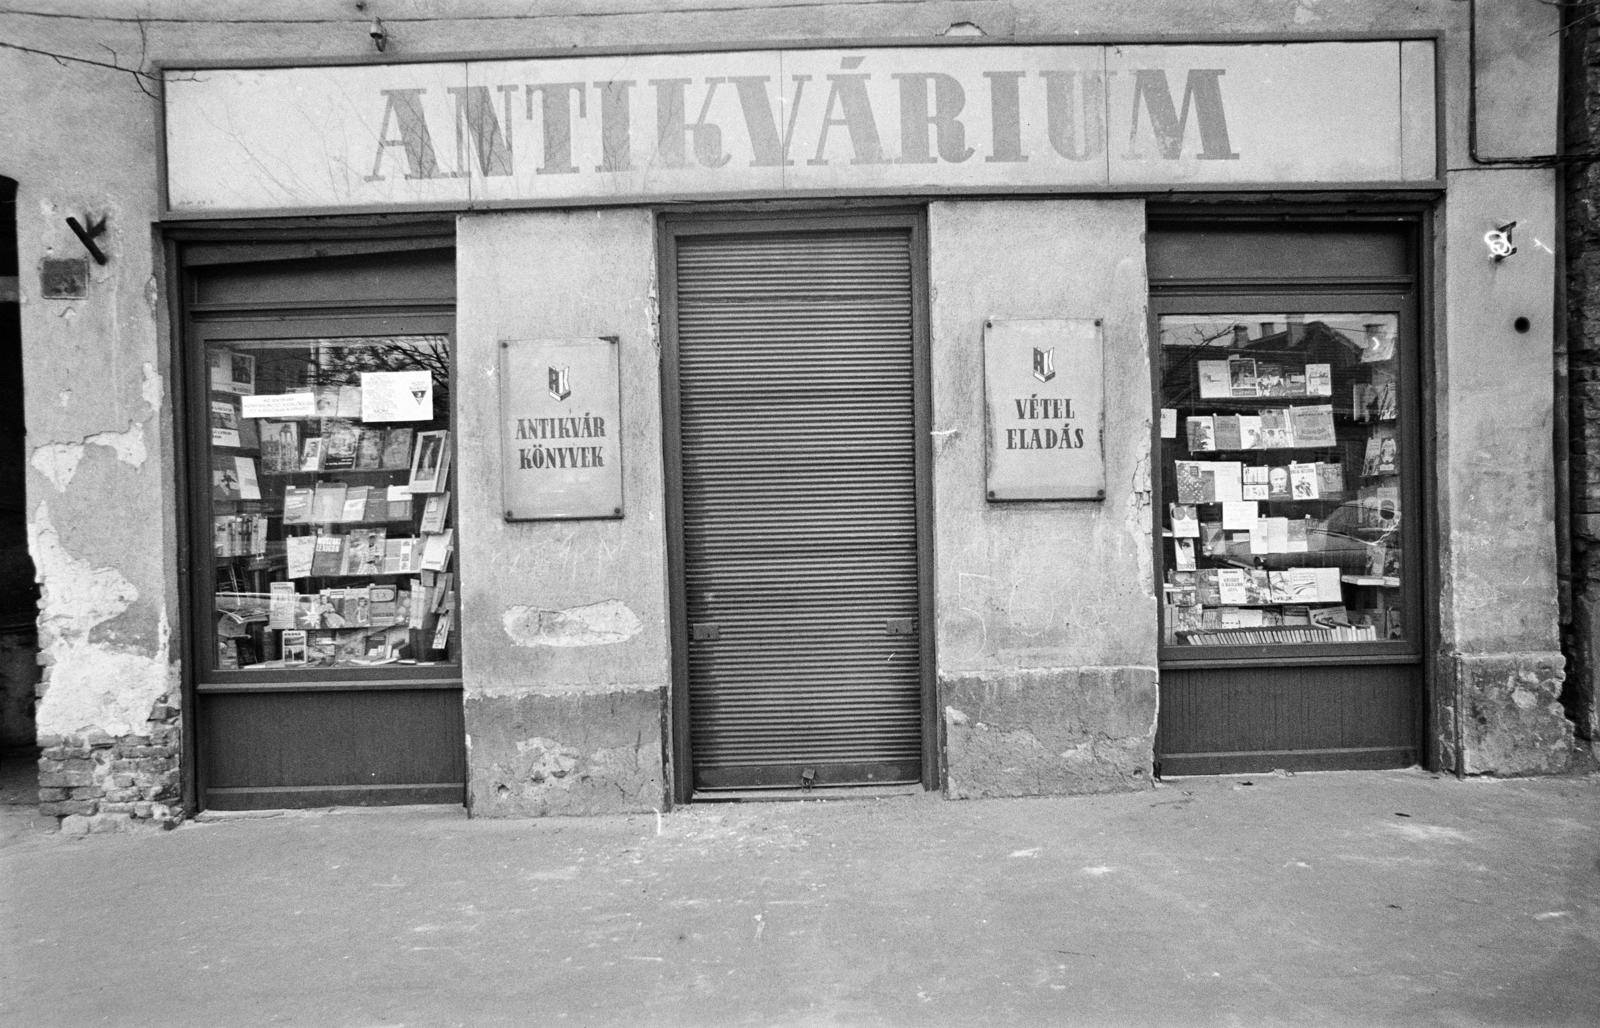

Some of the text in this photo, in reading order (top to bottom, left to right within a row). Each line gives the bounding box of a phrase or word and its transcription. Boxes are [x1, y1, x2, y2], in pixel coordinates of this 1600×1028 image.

[363, 56, 1240, 182] ANTIKVÁRIUM
[1015, 393, 1075, 419] VÉTEL
[515, 412, 606, 439] ANTIKVÁR
[1006, 423, 1084, 450] ELADÁS
[518, 444, 605, 470] KÖNYVEK
